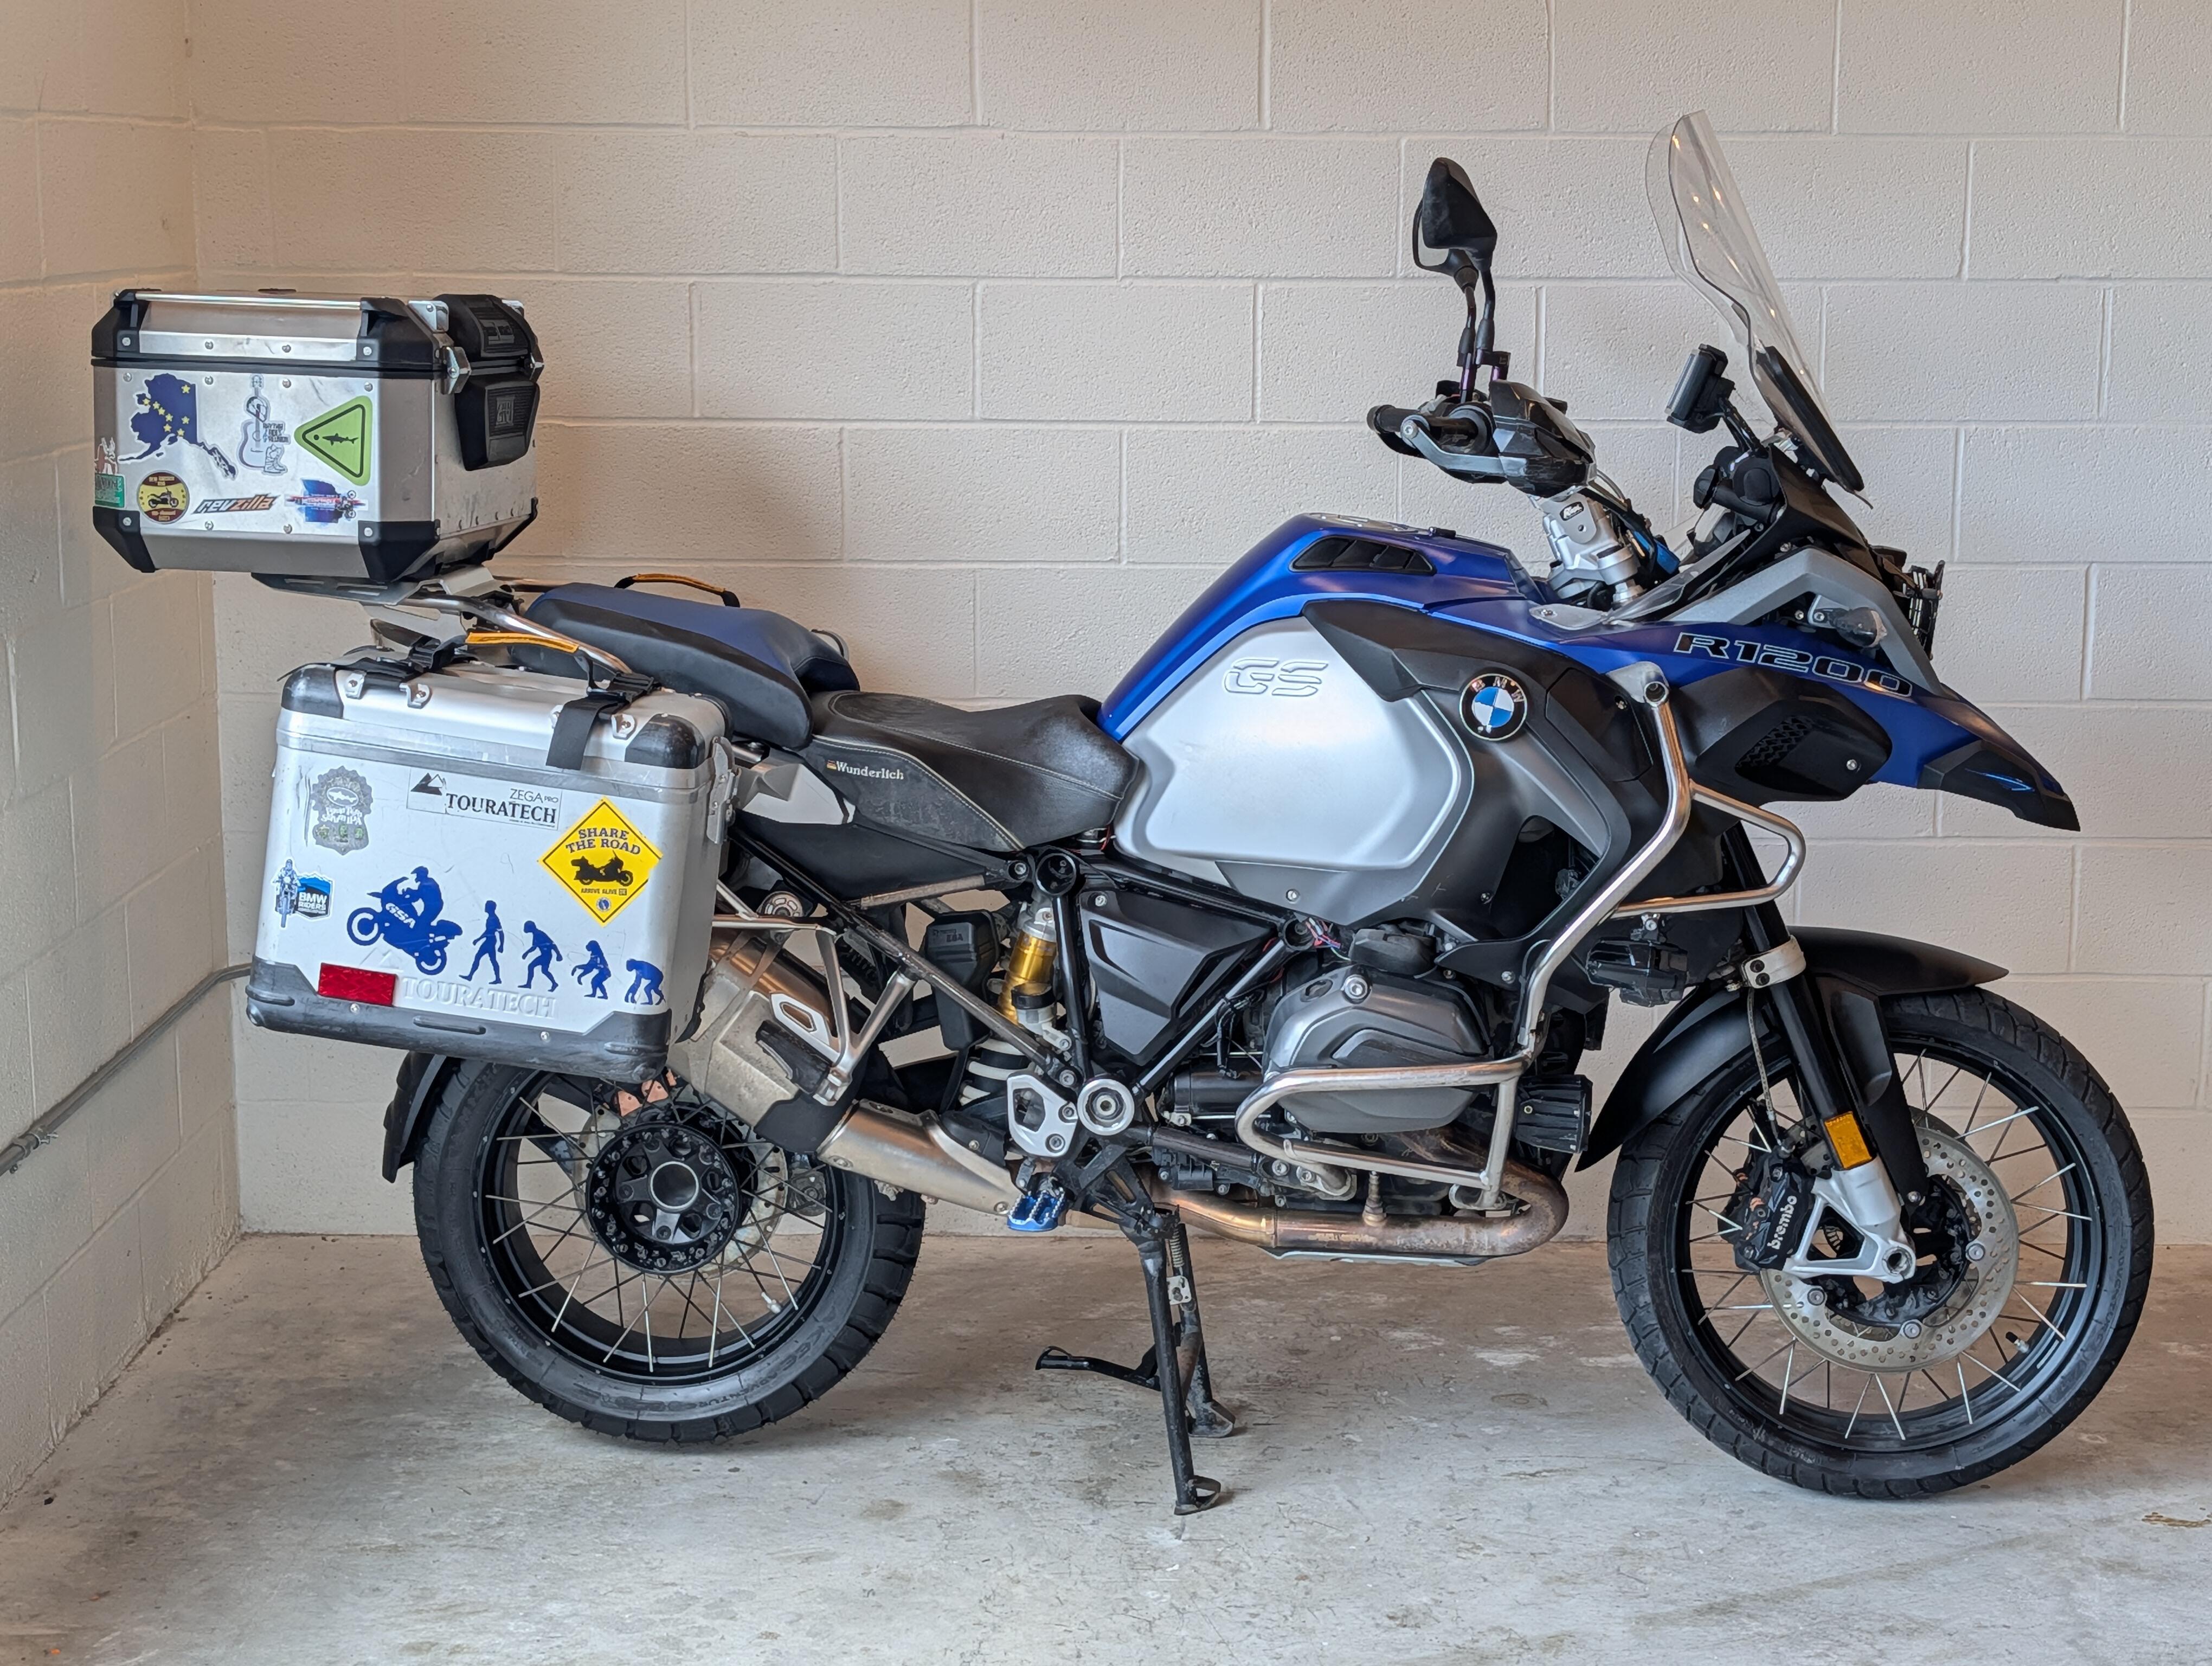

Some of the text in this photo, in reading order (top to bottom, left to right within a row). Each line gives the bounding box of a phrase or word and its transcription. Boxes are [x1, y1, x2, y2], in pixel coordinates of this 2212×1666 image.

[197, 495, 274, 514] revzilla
[1673, 632, 1913, 697] R1200
[1223, 658, 1329, 697] GS
[1470, 676, 1524, 702] BMW
[835, 760, 904, 780] Wunderlich
[510, 788, 543, 804] ZEGA
[446, 792, 557, 824] TOURATECH
[346, 815, 363, 825] IPA
[578, 828, 629, 840] SHARE
[565, 838, 641, 855] THE ROAD
[298, 901, 326, 911] RIDERS
[299, 892, 327, 905] BMW
[385, 903, 416, 928] GSA
[402, 976, 557, 1020] TOURATECH
[1766, 1195, 1797, 1250] brembo
